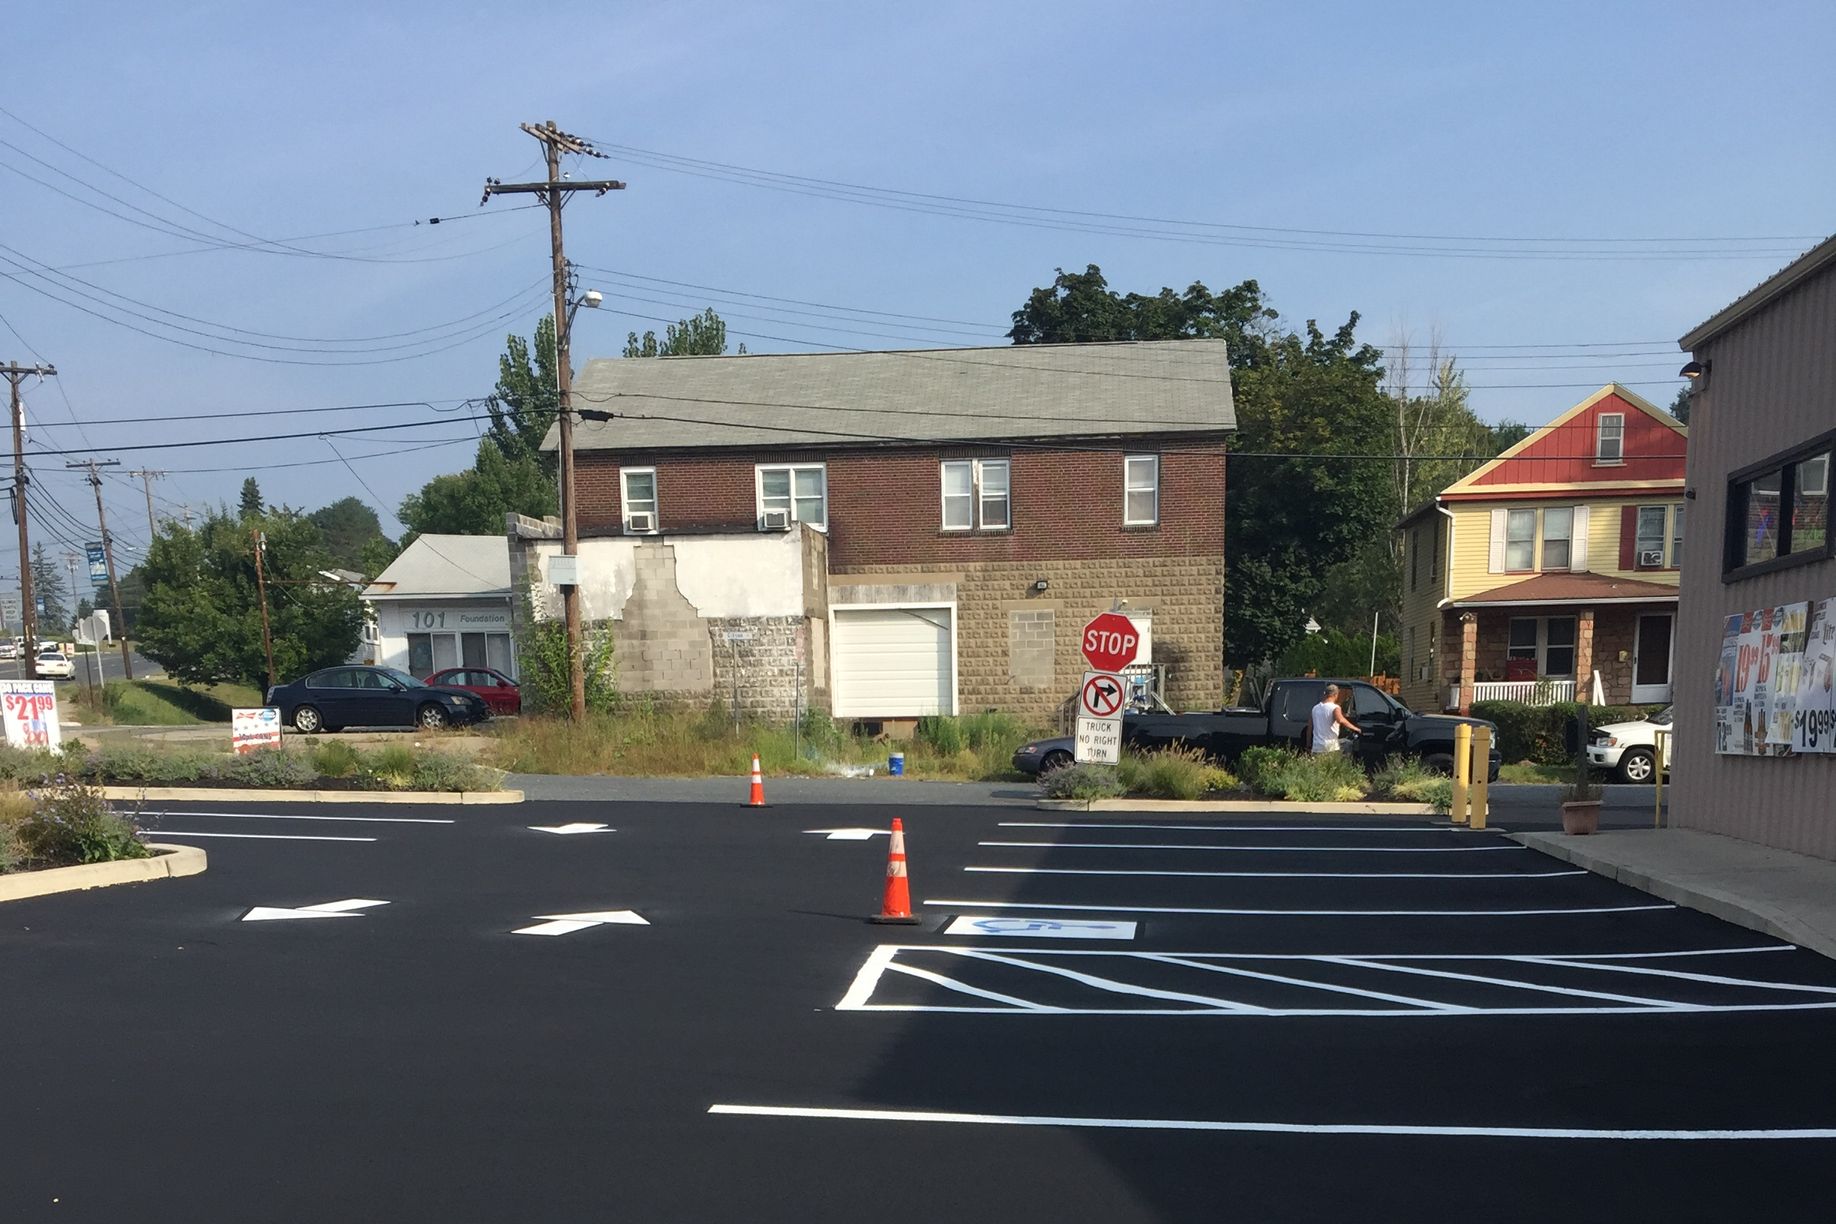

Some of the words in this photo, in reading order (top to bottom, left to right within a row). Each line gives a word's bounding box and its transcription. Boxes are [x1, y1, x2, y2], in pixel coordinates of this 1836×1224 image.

[412, 611, 446, 628] 101
[460, 614, 505, 623] Foundation
[1085, 629, 1136, 656] STOP
[1086, 721, 1112, 732] TRUCK
[1079, 734, 1090, 744] NO
[1094, 735, 1117, 746] RIGHT
[1087, 747, 1107, 759] TURN
